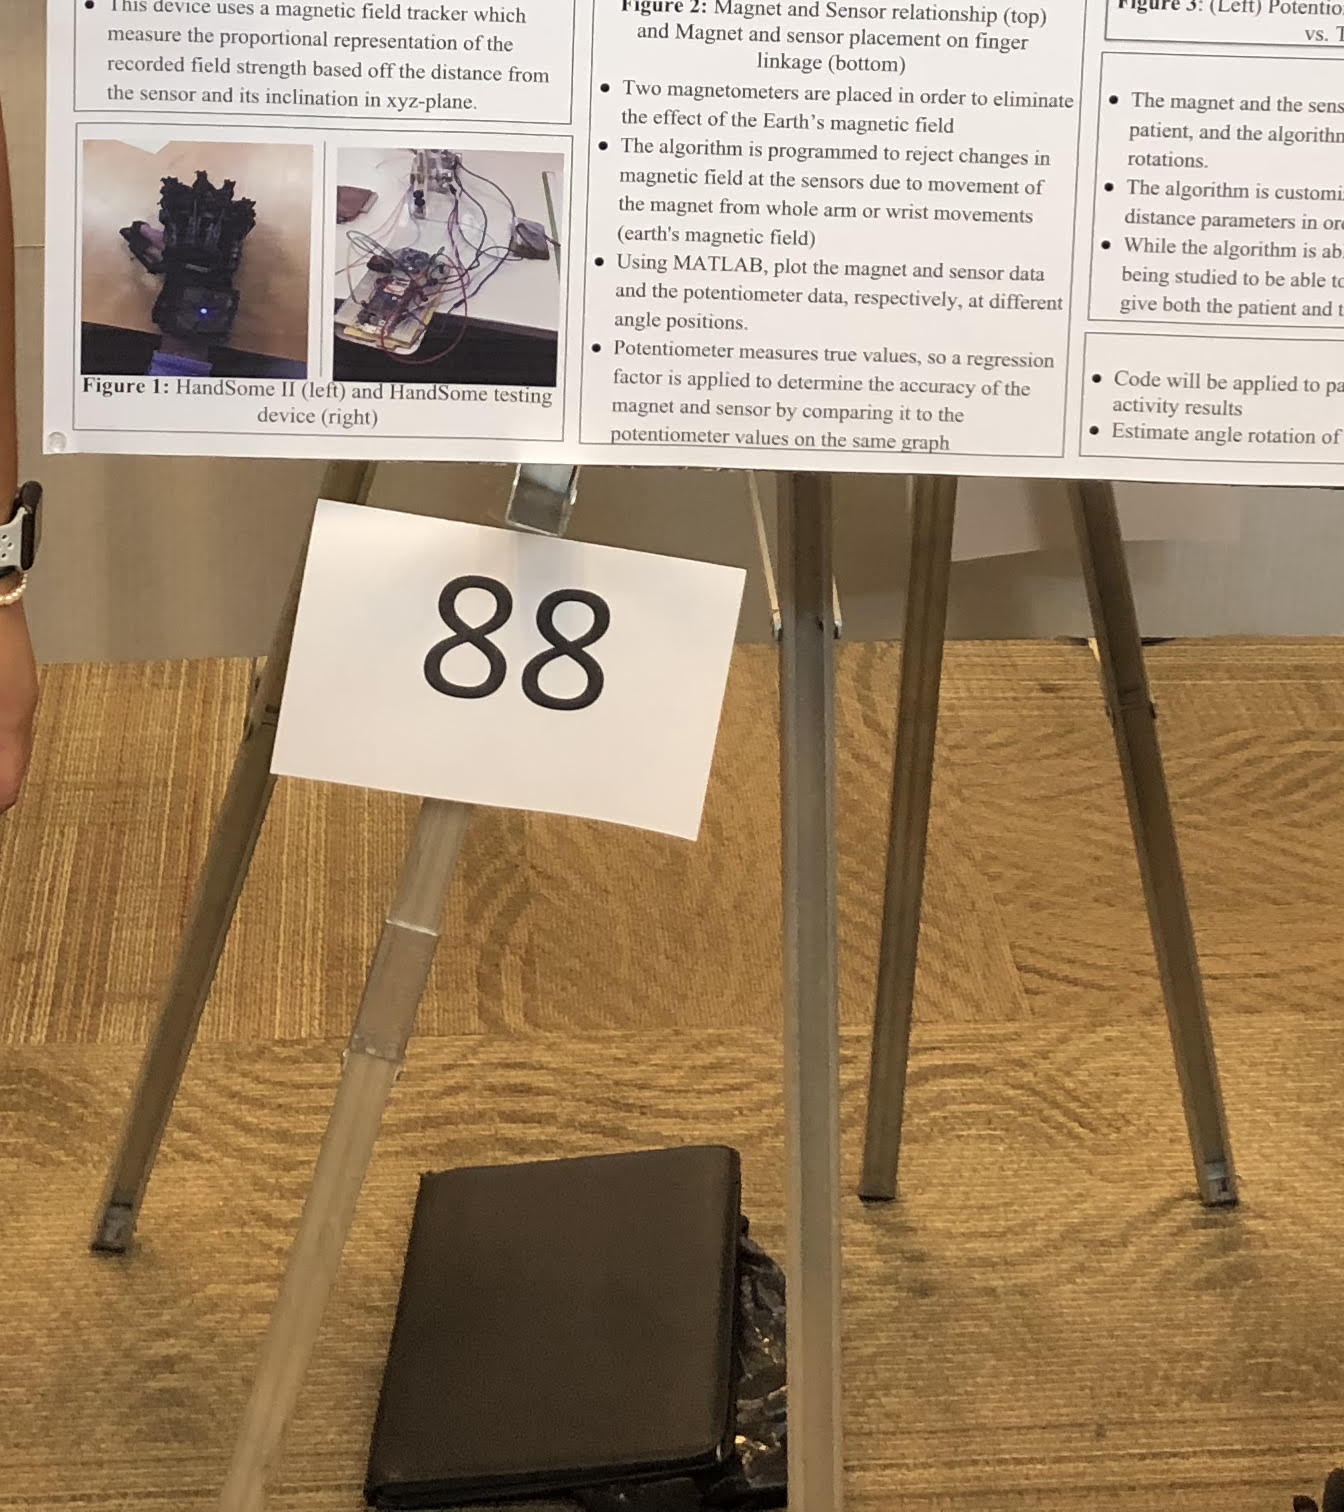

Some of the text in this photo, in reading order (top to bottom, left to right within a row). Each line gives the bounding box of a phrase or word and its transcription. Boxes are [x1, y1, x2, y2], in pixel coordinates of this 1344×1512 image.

[1304, 29, 1329, 42] vs.
[757, 51, 906, 76] linkage (bottom)
[617, 225, 816, 249] (earth's magnetic field)
[256, 406, 378, 429] device (right)
[1112, 396, 1243, 419] activity results
[423, 574, 611, 711] 88
